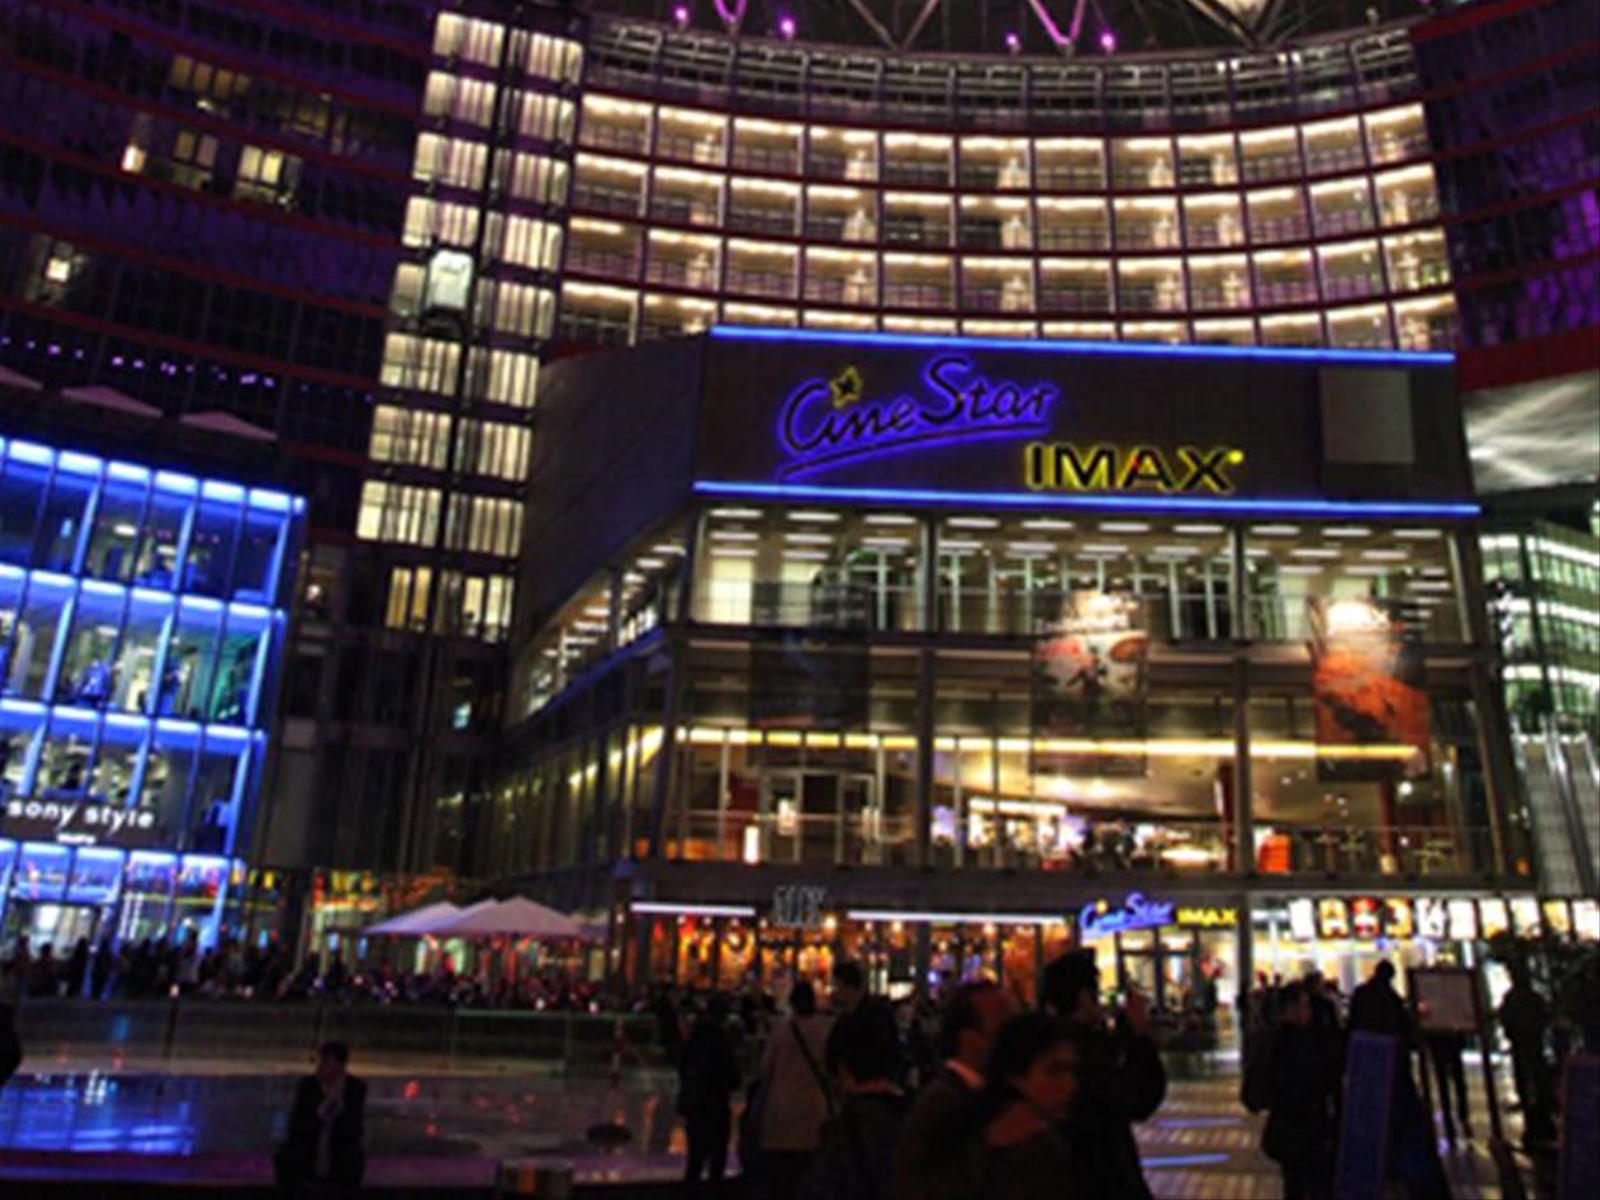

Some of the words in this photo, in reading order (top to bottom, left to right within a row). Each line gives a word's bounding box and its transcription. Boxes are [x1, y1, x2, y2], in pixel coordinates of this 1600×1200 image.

[778, 352, 1059, 462] CineStar
[1025, 441, 1238, 494] IMAX
[7, 800, 79, 831] sony
[84, 805, 154, 837] style
[1176, 907, 1239, 927] IMAX
